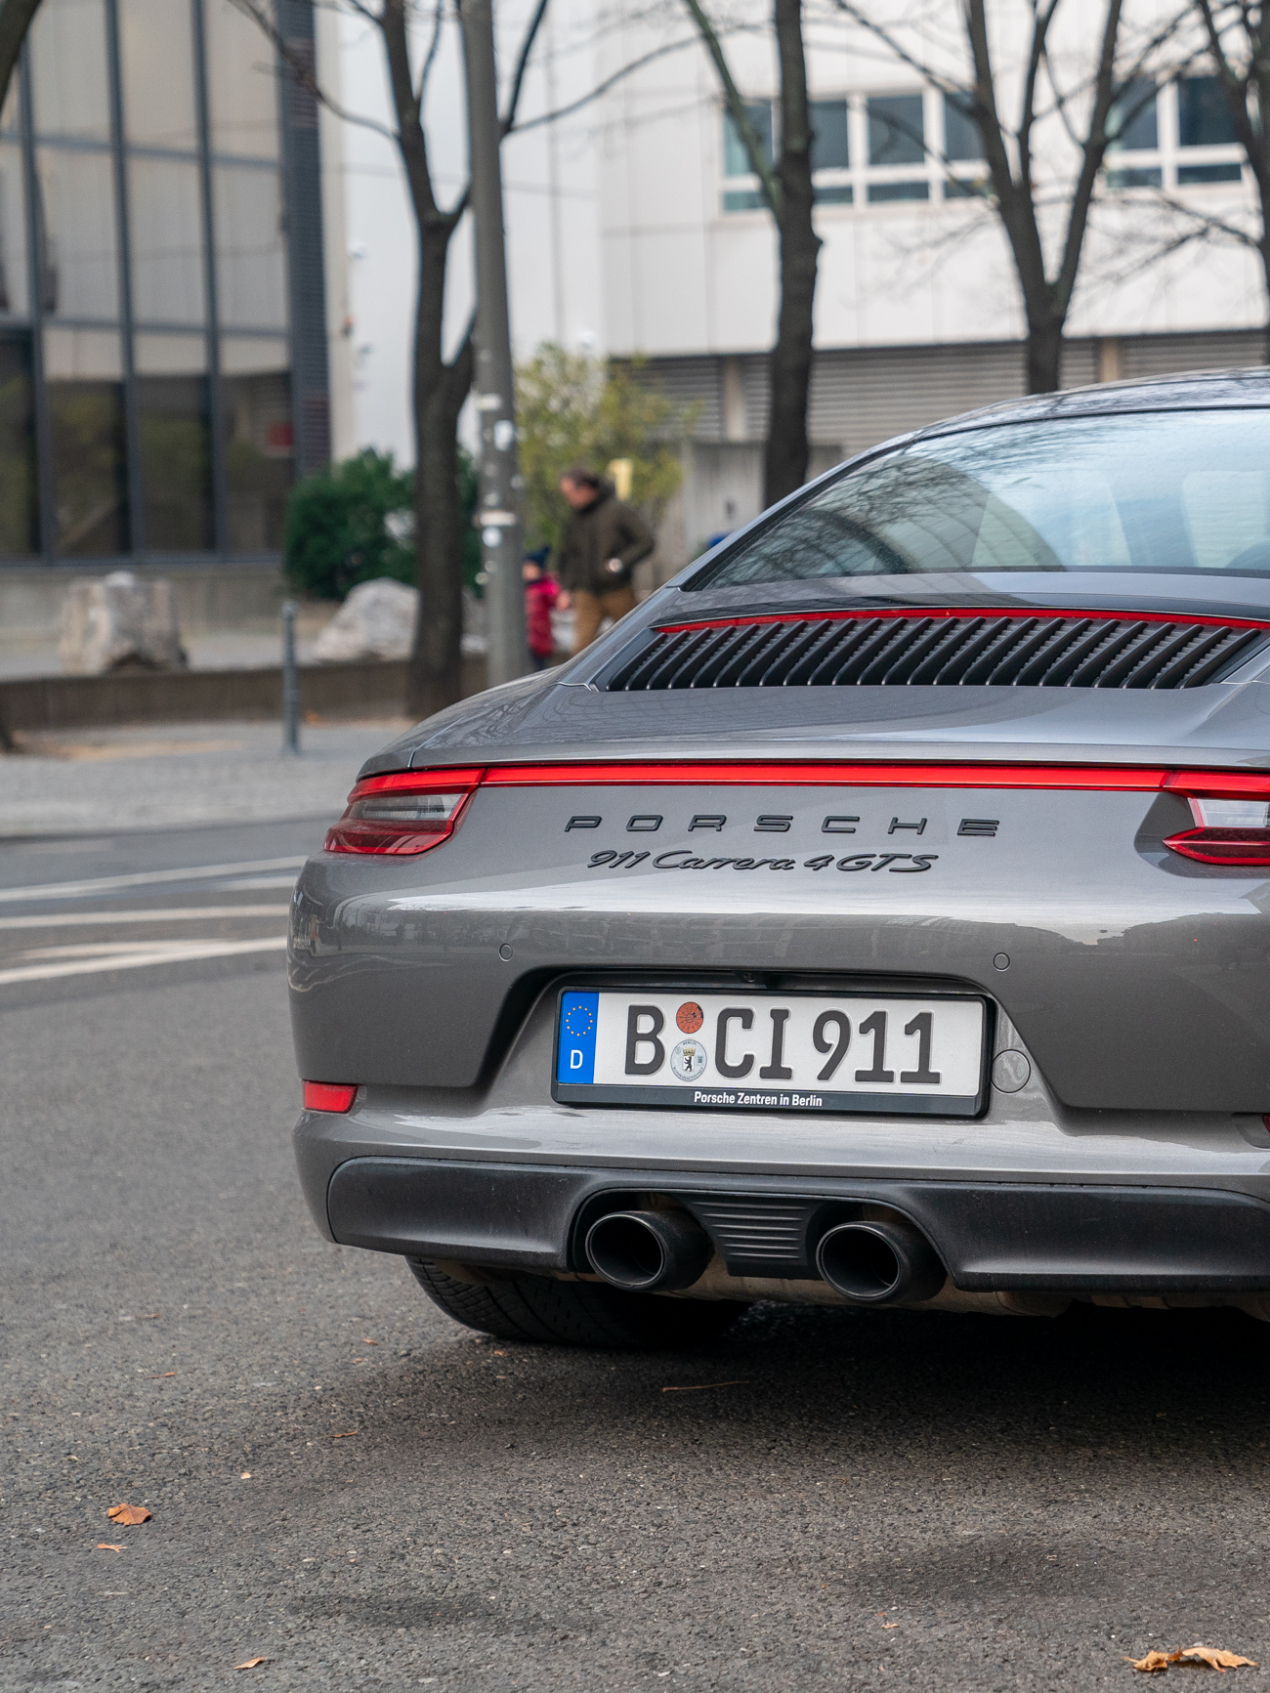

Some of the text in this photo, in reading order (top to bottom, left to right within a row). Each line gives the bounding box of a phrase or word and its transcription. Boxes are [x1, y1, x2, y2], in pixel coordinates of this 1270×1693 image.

[564, 815, 1000, 837] PORSCHE
[587, 850, 650, 869] 911
[652, 850, 796, 870] Carrera
[624, 1005, 666, 1075] B
[714, 1008, 792, 1080] CI
[812, 1009, 941, 1084] 911
[569, 1049, 583, 1069] D
[694, 1091, 823, 1107] Porsche Zentren in Berlin
